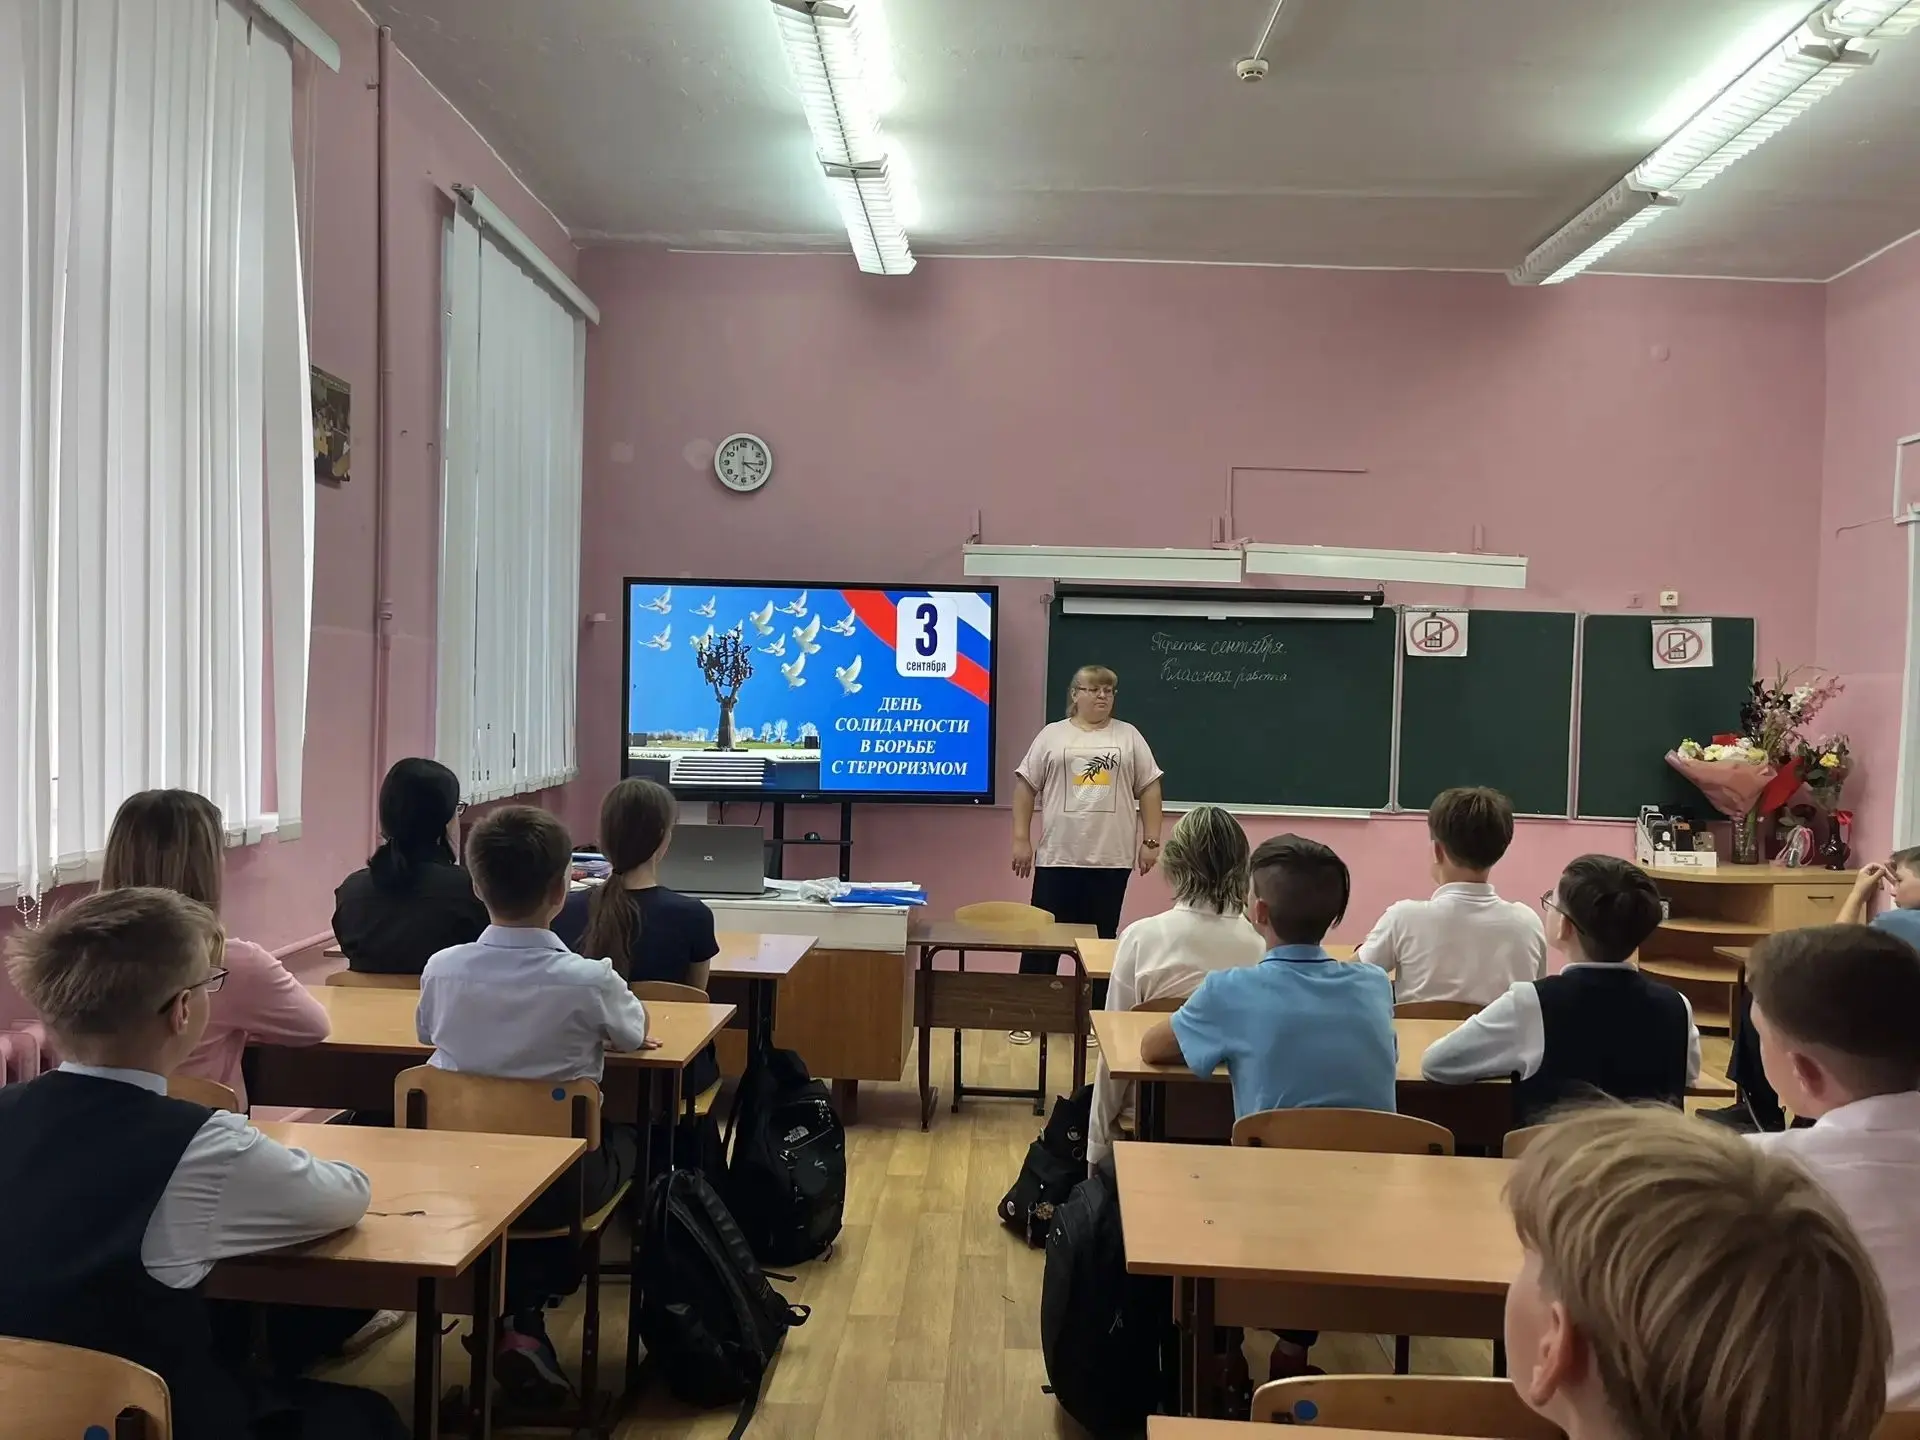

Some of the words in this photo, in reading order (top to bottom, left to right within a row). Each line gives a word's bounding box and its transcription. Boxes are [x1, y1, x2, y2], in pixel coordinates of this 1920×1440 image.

[915, 602, 938, 657] 3
[1151, 631, 1207, 655] Третье
[906, 660, 947, 673] сентября
[877, 696, 922, 713] ДЕНЬ
[834, 717, 970, 735] СОЛИДАРНОСТИ
[859, 739, 871, 753] В
[874, 739, 937, 754] БОРЬБЕ
[831, 760, 844, 774] С
[847, 760, 968, 776] ТЕРРОРИЗМОМ
